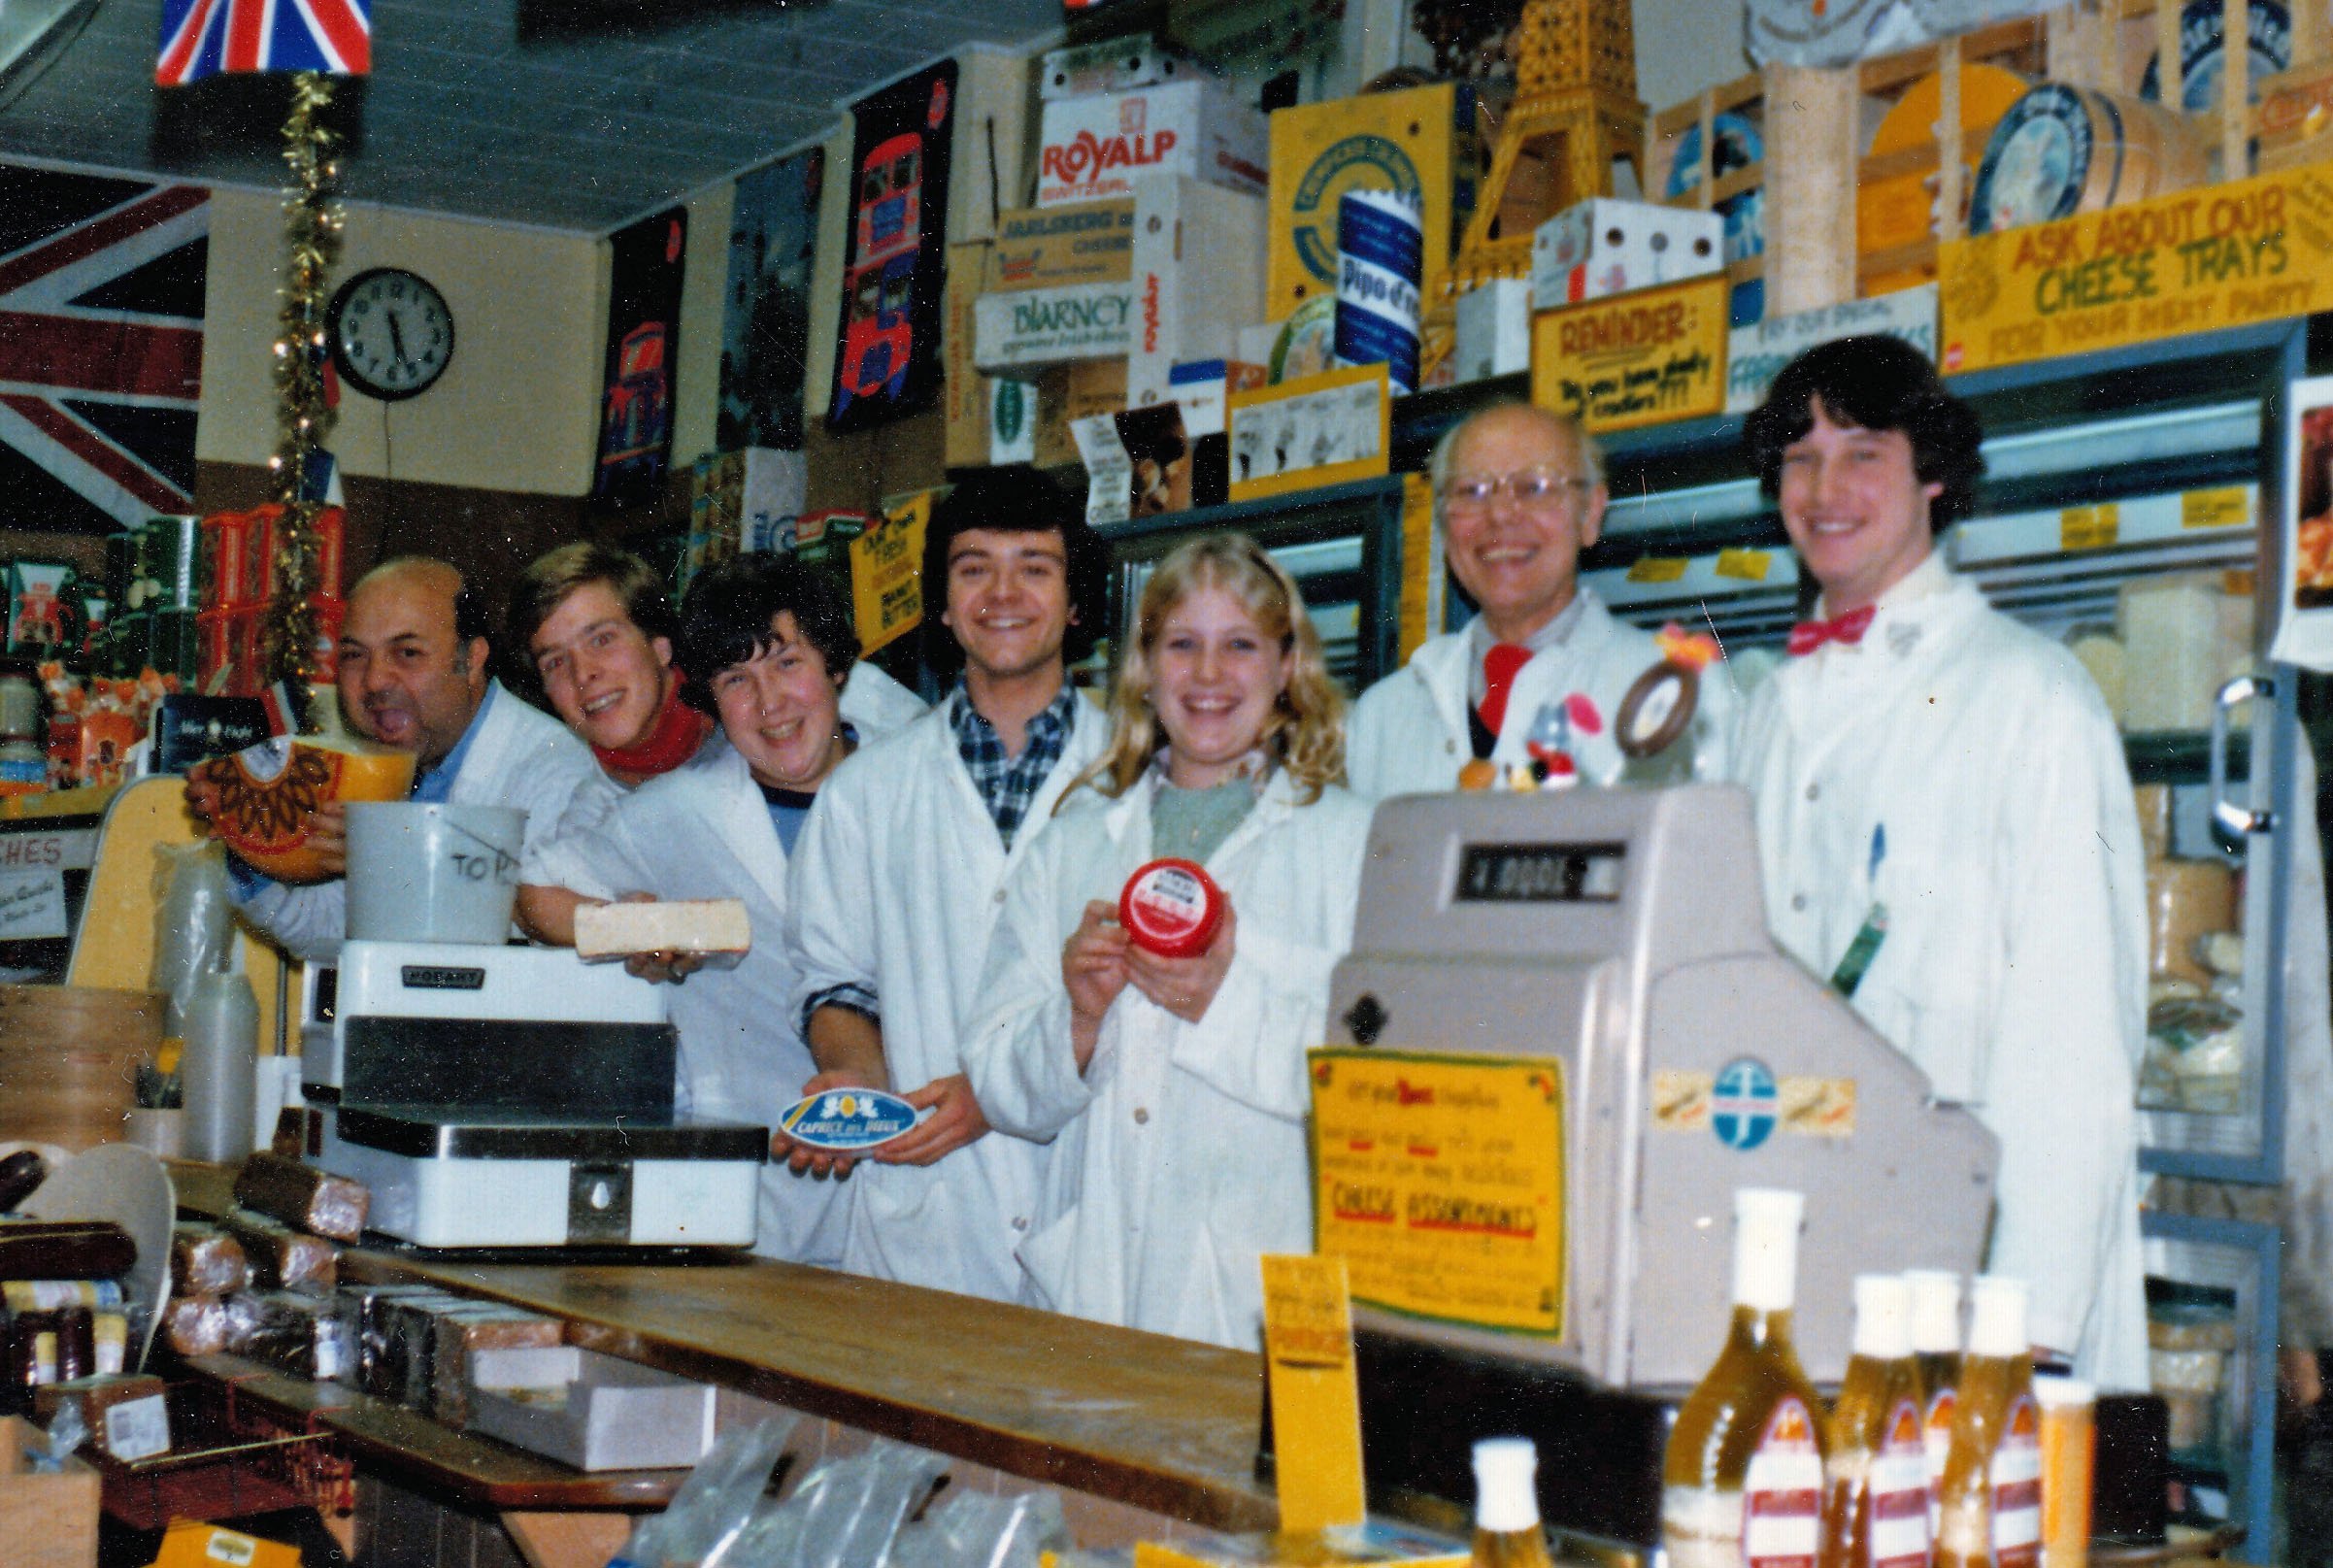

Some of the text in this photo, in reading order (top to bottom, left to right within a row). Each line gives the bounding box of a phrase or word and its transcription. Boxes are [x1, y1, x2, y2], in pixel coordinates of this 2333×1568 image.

[1043, 129, 1177, 183] ROYALP
[1042, 179, 1132, 200] SWITZERL
[1003, 211, 1114, 239] JARLSBERG
[2012, 184, 2287, 273] ASK ABOUT OUR
[1343, 257, 1386, 301] Pipo
[2035, 233, 2287, 316] CHEESE TRAYS
[1989, 318, 2045, 362] FOR
[2226, 279, 2317, 317] PARTY
[1333, 1182, 1395, 1216] CHEESE
